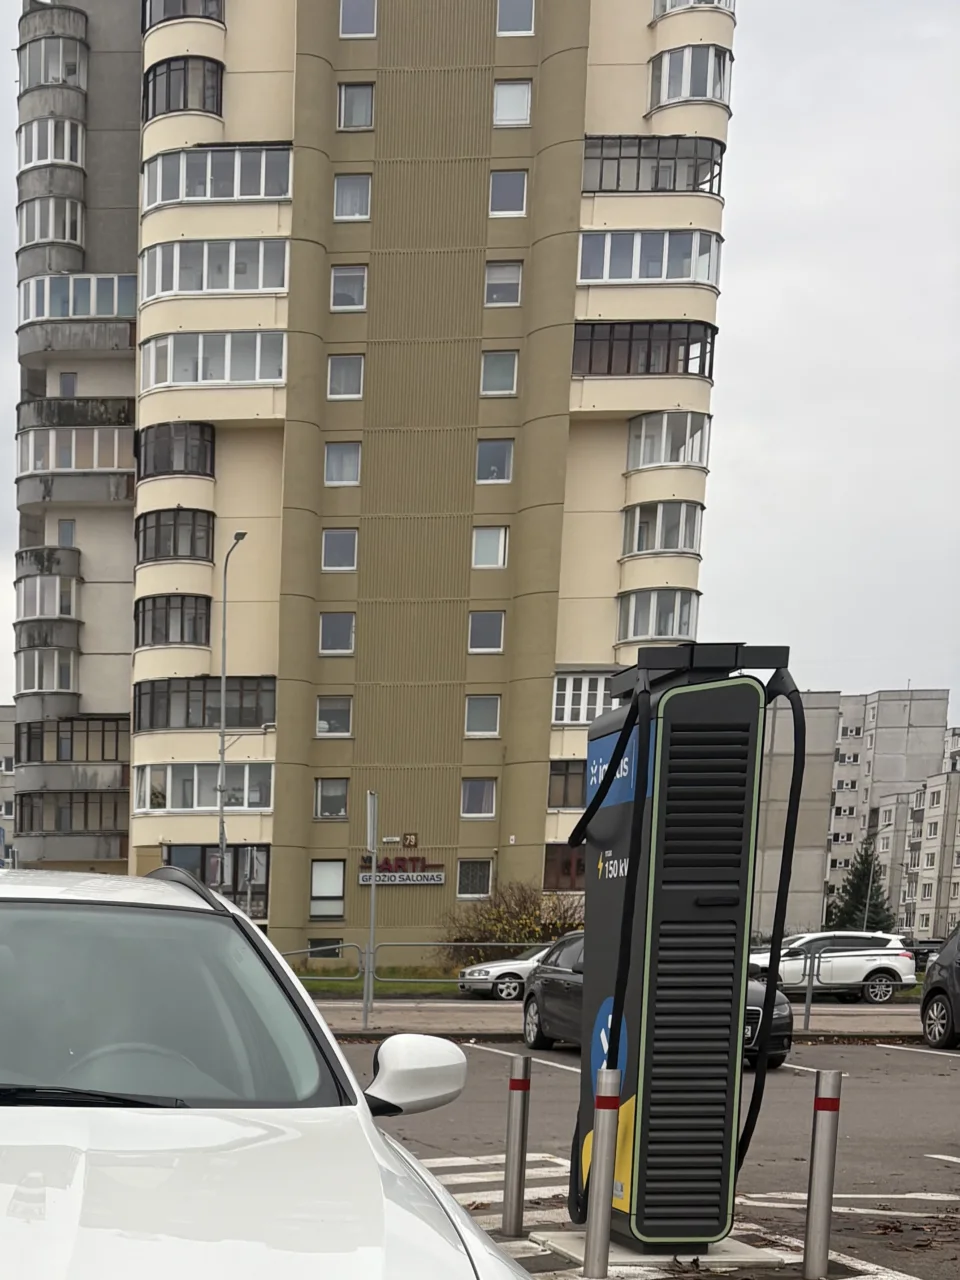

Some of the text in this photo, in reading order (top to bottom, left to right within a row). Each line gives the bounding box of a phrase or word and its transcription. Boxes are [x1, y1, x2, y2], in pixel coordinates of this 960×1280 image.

[405, 835, 416, 846] 79
[380, 857, 425, 873] ARTI
[605, 859, 619, 879] 150
[398, 874, 443, 882] SALONAS
